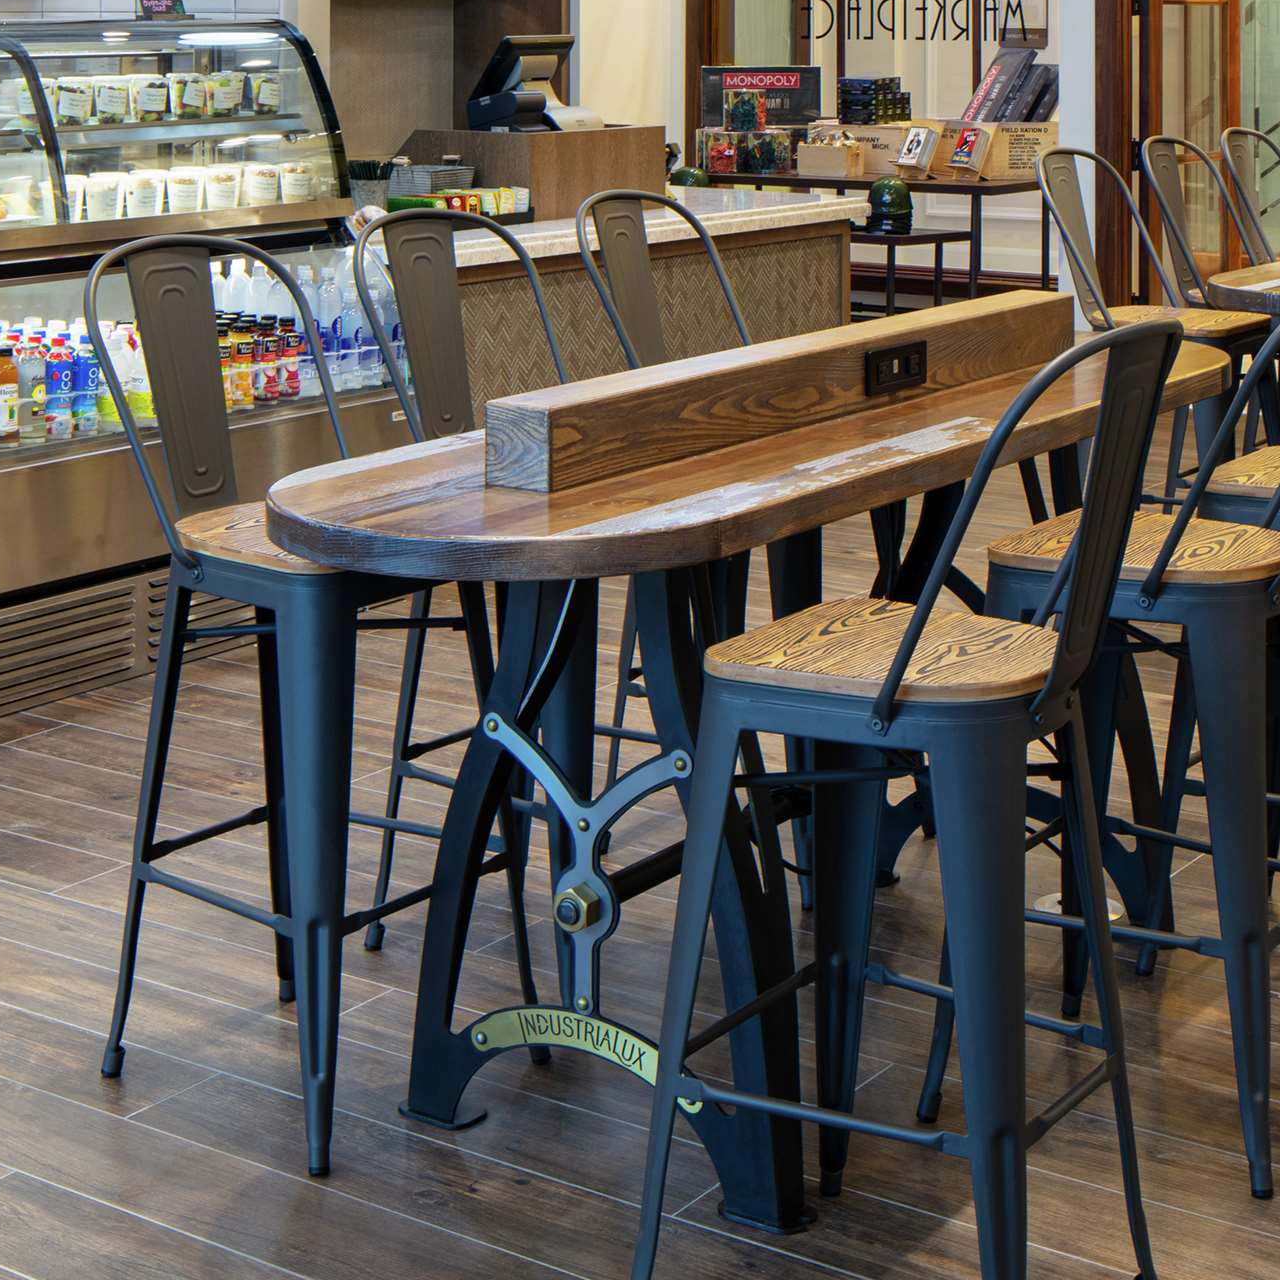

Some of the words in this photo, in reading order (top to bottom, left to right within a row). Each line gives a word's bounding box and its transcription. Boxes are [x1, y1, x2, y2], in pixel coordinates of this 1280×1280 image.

[725, 75, 797, 86] MONOPOLY
[964, 64, 1001, 122] ONOPOLY
[516, 1011, 647, 1071] INDUSTRIALUX
